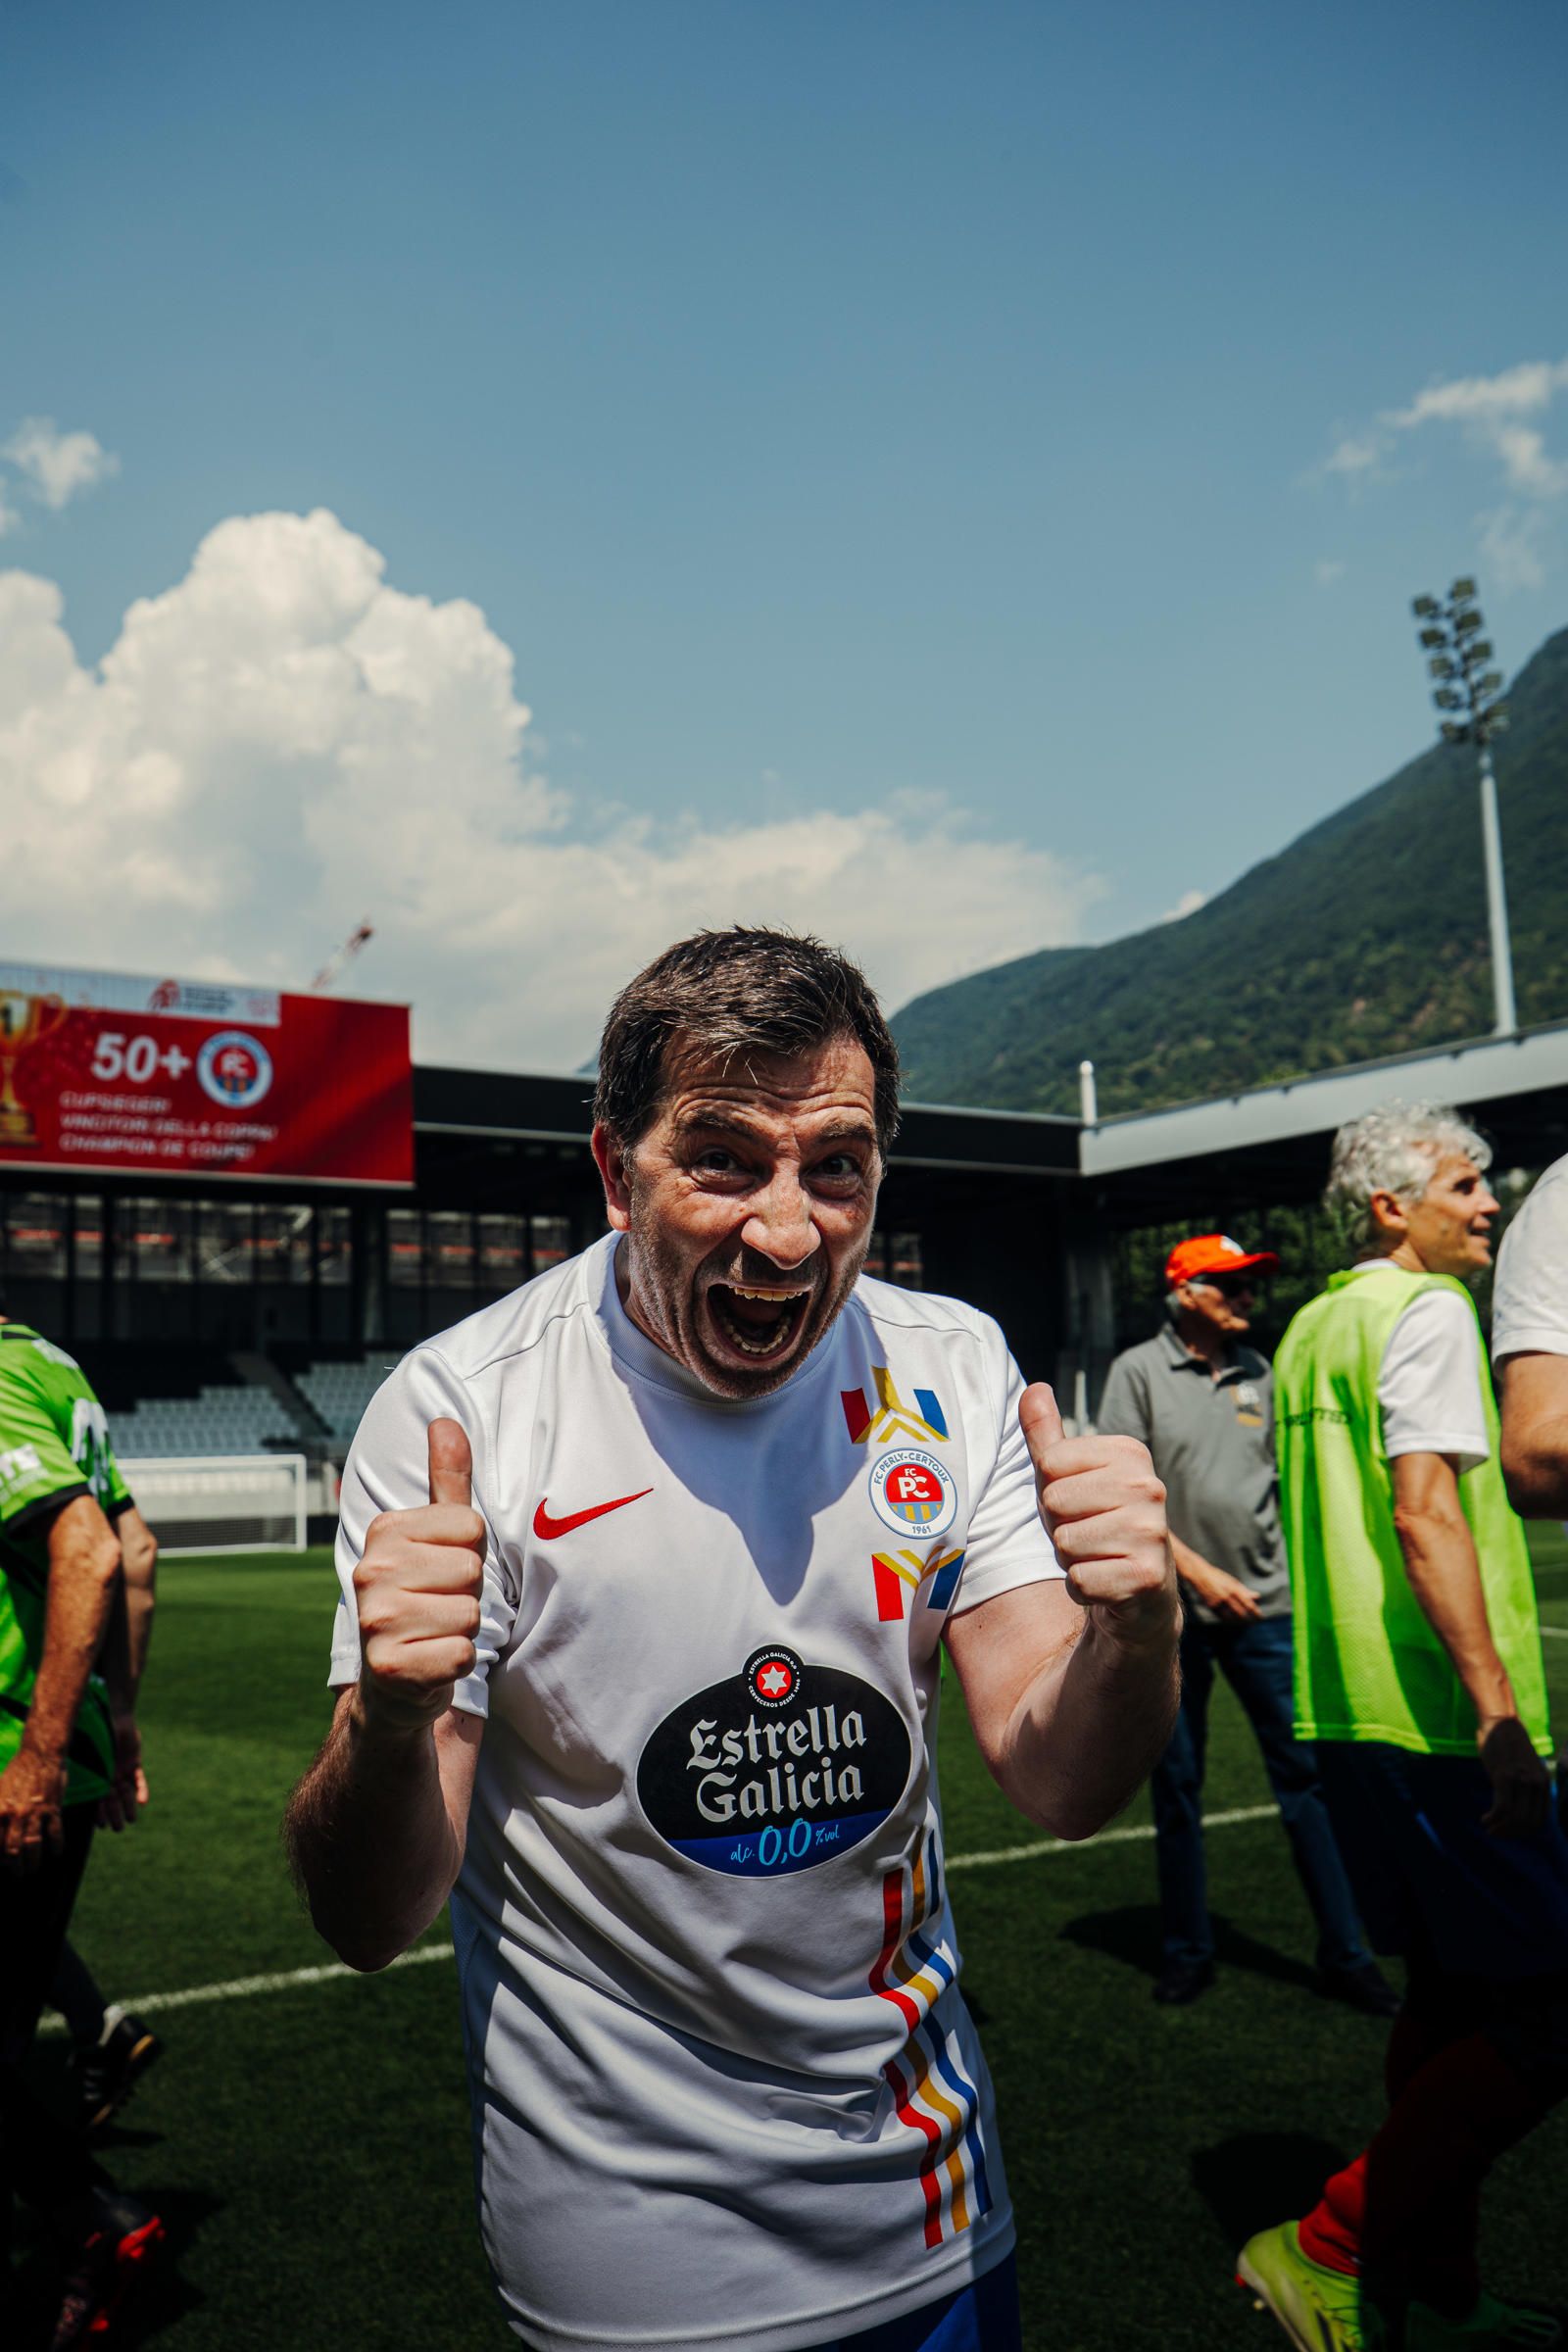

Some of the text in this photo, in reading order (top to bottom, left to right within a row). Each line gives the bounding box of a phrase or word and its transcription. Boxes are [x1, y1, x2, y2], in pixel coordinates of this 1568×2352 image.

[91, 1032, 191, 1082] 50+
[60, 1133, 156, 1154] CHAMPION
[159, 1140, 184, 1156] DE
[879, 1452, 949, 1484] PERLY-CERTOUX
[904, 1468, 917, 1477] FC
[898, 1476, 931, 1499] PC
[911, 1525, 932, 1535] 1961
[749, 1653, 769, 1675] ESTRELLA
[769, 1651, 791, 1662] GALICIA
[749, 1685, 778, 1707] CERVECEROS
[779, 1692, 796, 1706] DESDE
[686, 1704, 867, 1770] Estrella
[697, 1757, 864, 1822] Galicia
[730, 1842, 756, 1863] alc.
[759, 1818, 812, 1866] 0,0
